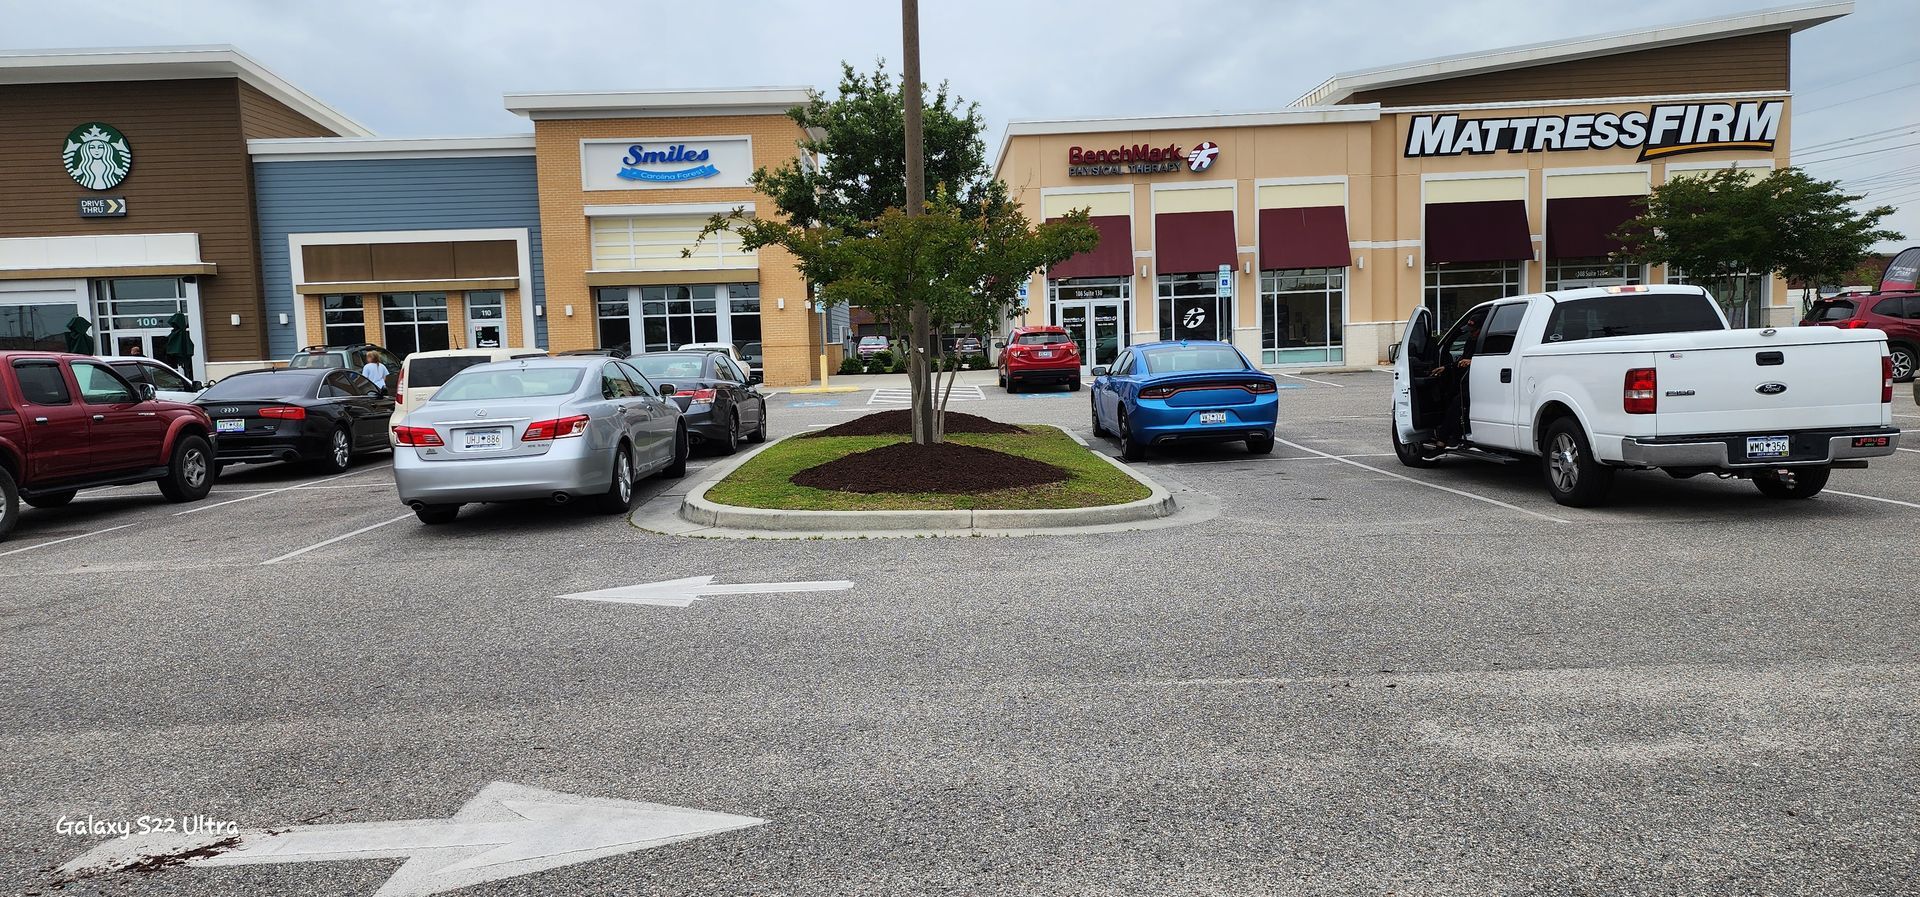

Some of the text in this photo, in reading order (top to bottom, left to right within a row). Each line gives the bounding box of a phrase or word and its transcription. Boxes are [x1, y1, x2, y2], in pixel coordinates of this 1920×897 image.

[623, 145, 709, 165] Smiles
[1069, 144, 1184, 164] BenchMark
[640, 172, 676, 180] Carolina
[677, 169, 704, 179] Forest
[1069, 162, 1182, 177] PHYSICAL THERAPY
[136, 317, 158, 326] 100
[1763, 384, 1782, 393] Ford
[487, 434, 500, 443] 886
[1856, 437, 1887, 446] JESUS
[1771, 441, 1786, 451] 356
